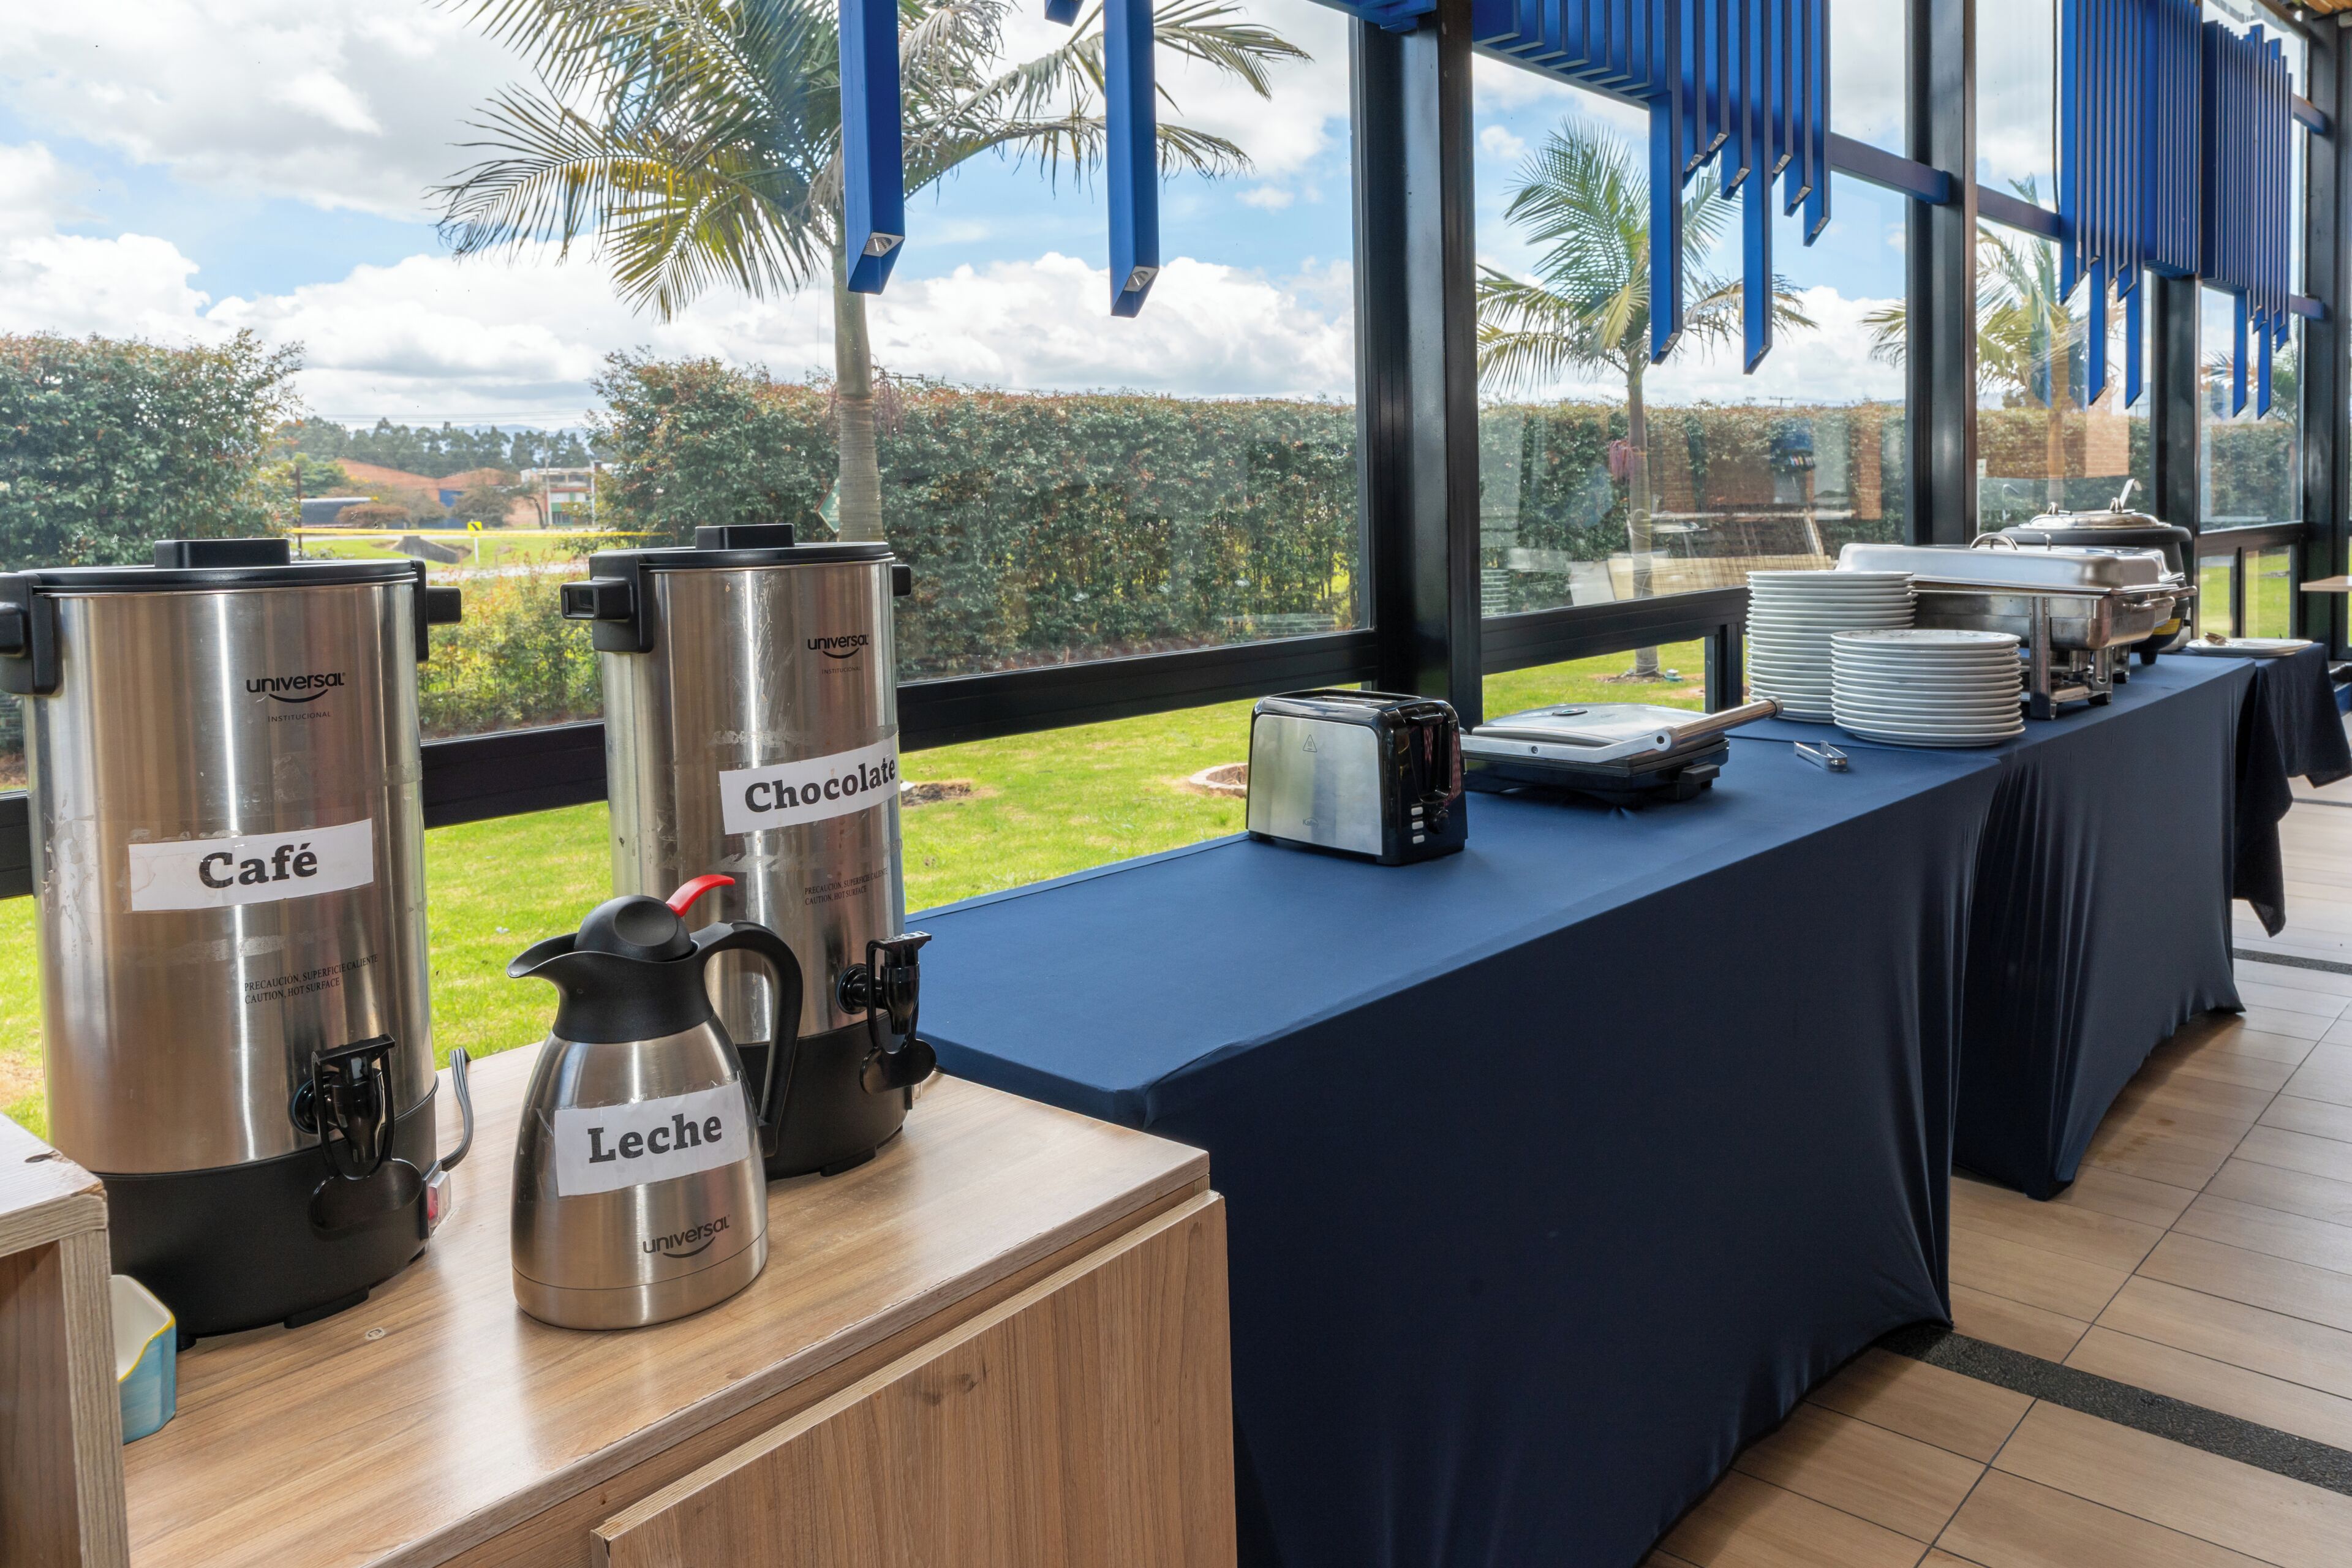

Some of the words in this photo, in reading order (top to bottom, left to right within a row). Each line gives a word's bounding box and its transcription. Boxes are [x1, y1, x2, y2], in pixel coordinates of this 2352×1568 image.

[807, 634, 869, 650] universal
[821, 666, 862, 674] INSTITUCIONAL
[246, 672, 345, 693] universal
[268, 710, 331, 723] INSTITUCIONAL
[745, 758, 895, 813] Chocolate
[198, 842, 318, 889] Café
[834, 890, 847, 900] HOT
[846, 885, 867, 897] SURFACE
[844, 873, 872, 888] SUPERFICIE
[244, 973, 301, 992] PRECAUCIÓN,
[303, 963, 346, 981] SUPERFICIE
[347, 954, 379, 971] CALIENTE
[245, 989, 287, 1005] CAUTION,
[288, 985, 306, 997] HOT
[306, 977, 341, 993] SURFACE
[587, 1113, 722, 1163] Leche
[643, 1216, 729, 1253] universal
